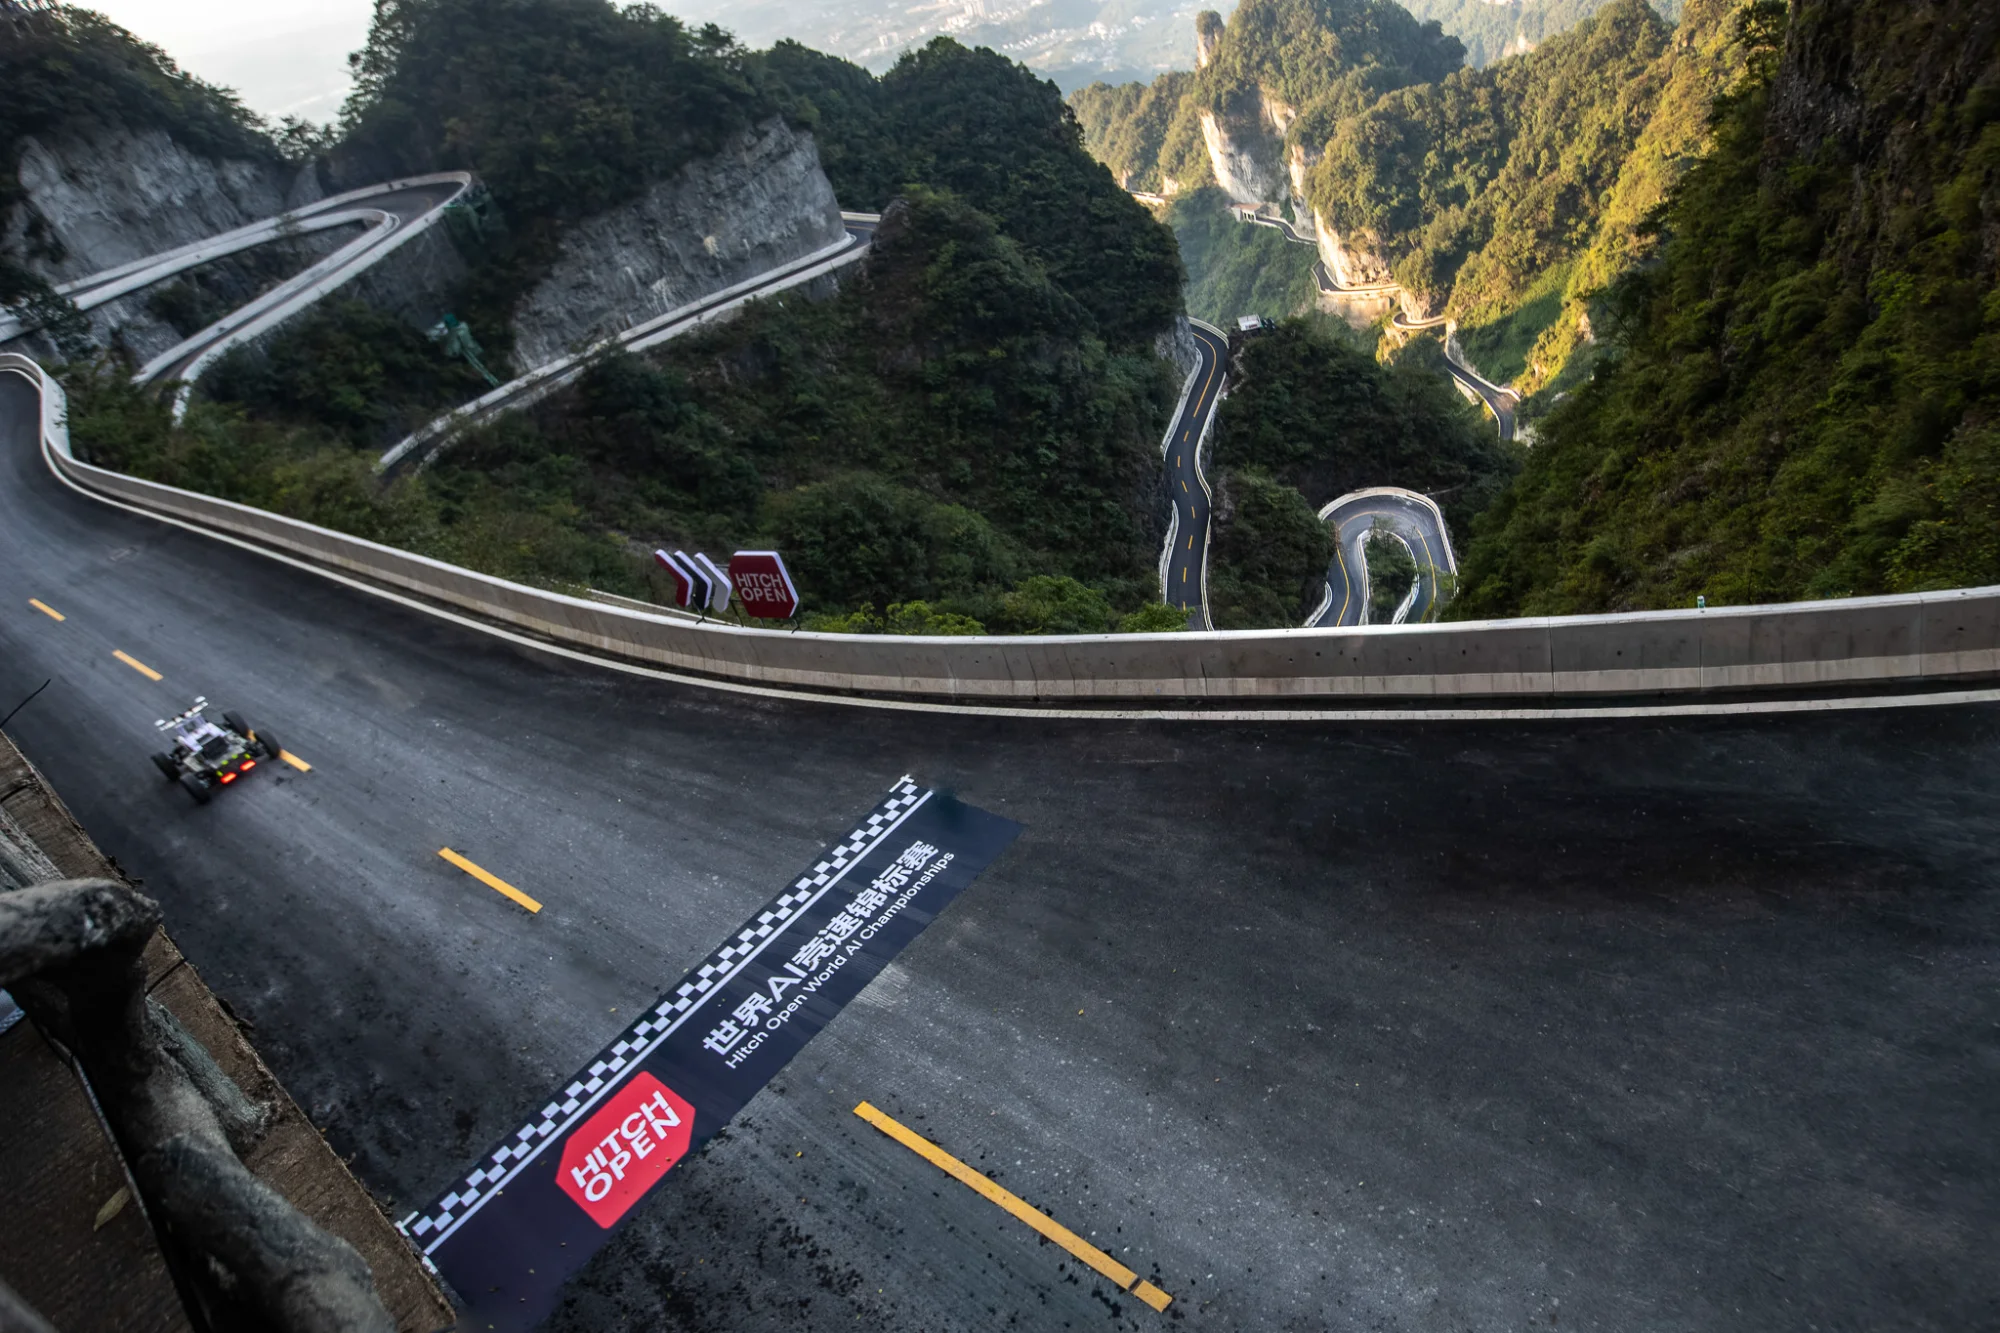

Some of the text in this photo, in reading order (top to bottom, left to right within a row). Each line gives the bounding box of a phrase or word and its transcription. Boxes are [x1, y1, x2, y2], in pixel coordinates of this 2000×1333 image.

[735, 573, 783, 588] HITCH
[741, 588, 788, 602] OPEN
[702, 840, 939, 1056] 世界AI竞速锦标赛
[725, 852, 955, 1069] Hitch Open World AI Championships
[570, 1090, 670, 1189] HITCH
[584, 1106, 682, 1202] OPEN
